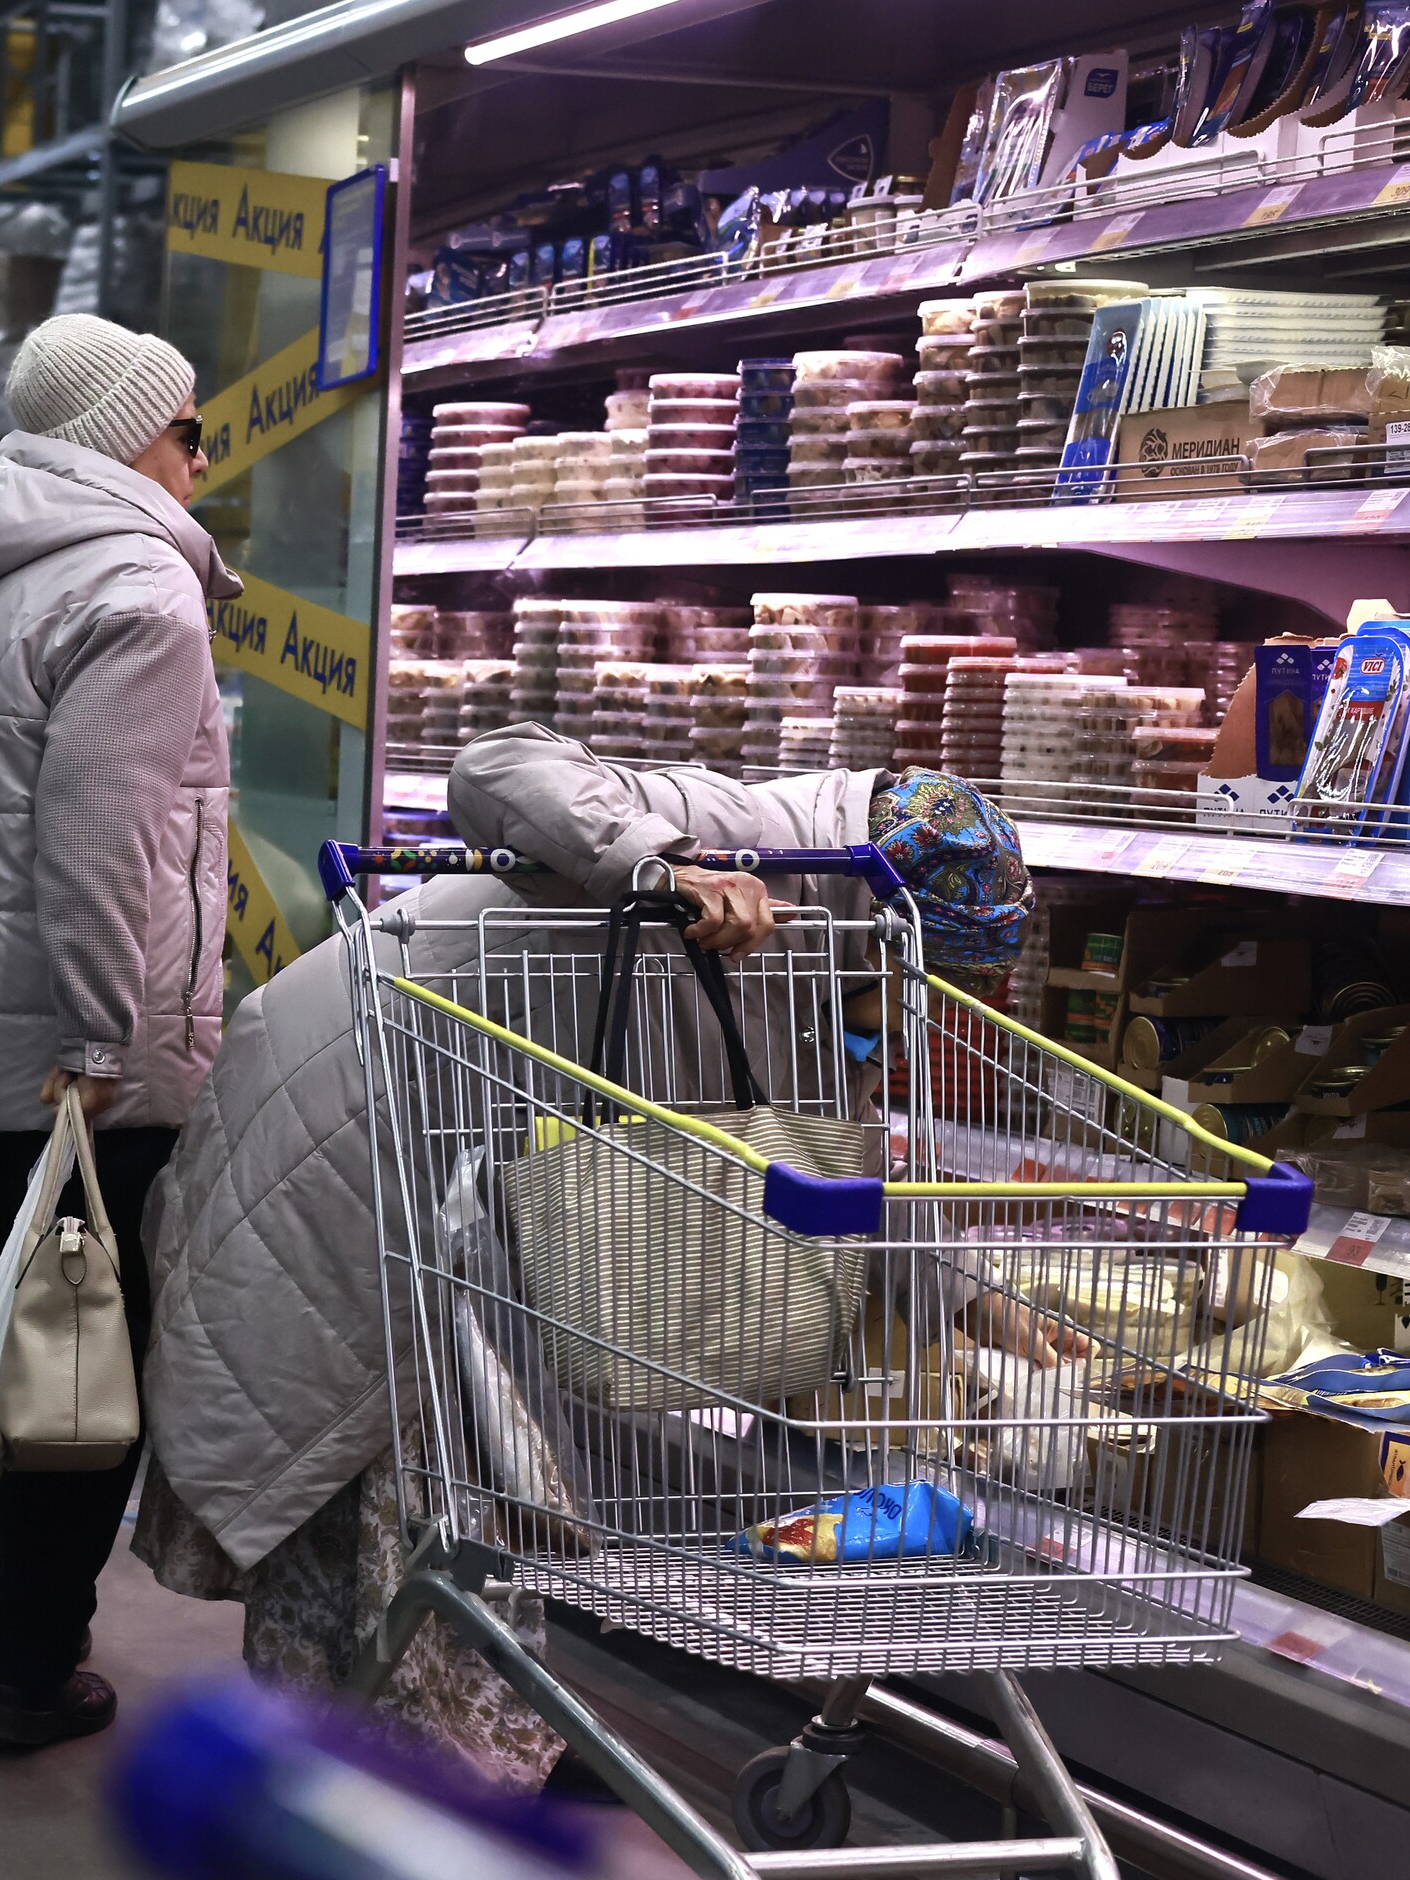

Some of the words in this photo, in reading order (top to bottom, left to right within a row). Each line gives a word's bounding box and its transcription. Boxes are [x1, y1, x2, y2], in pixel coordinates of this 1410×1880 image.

[174, 193, 219, 240] кция
[232, 183, 304, 256] Акция
[1172, 438, 1240, 460] МЕРИДИАН
[1170, 465, 1200, 476] ОСНОВАН
[280, 611, 356, 697] Акция
[1362, 660, 1383, 672] VICI
